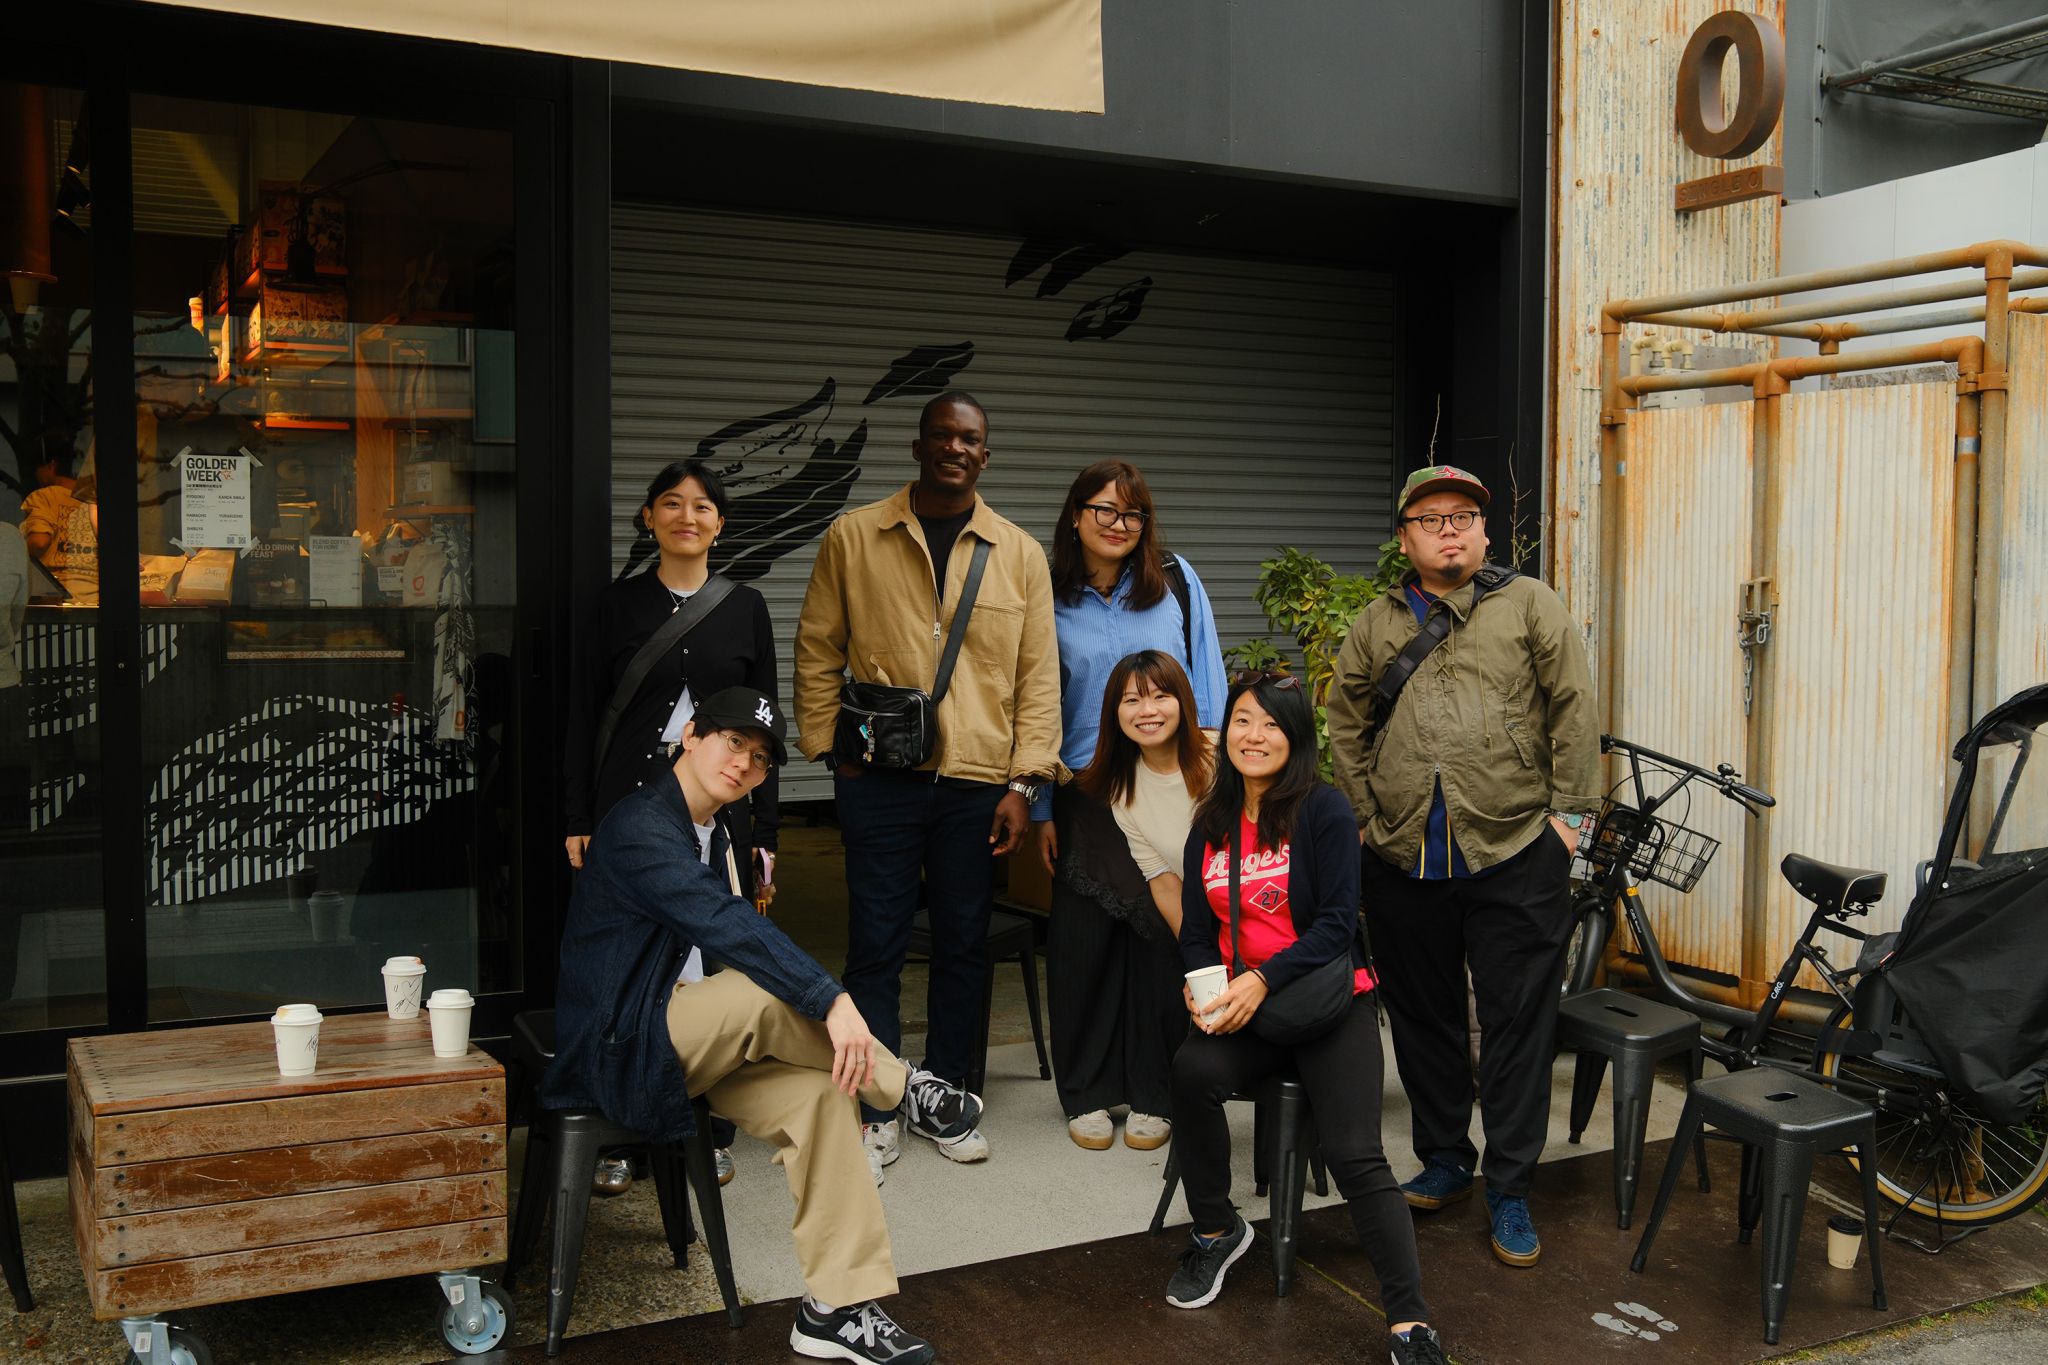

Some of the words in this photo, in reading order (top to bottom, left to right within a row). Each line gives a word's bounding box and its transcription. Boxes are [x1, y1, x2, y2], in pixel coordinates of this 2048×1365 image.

[1679, 175, 1742, 202] SINGLE
[1748, 171, 1759, 188] O
[186, 457, 237, 470] GOLDEN
[186, 470, 222, 482] WEEK
[755, 697, 774, 727] LA
[1261, 890, 1281, 906] 27
